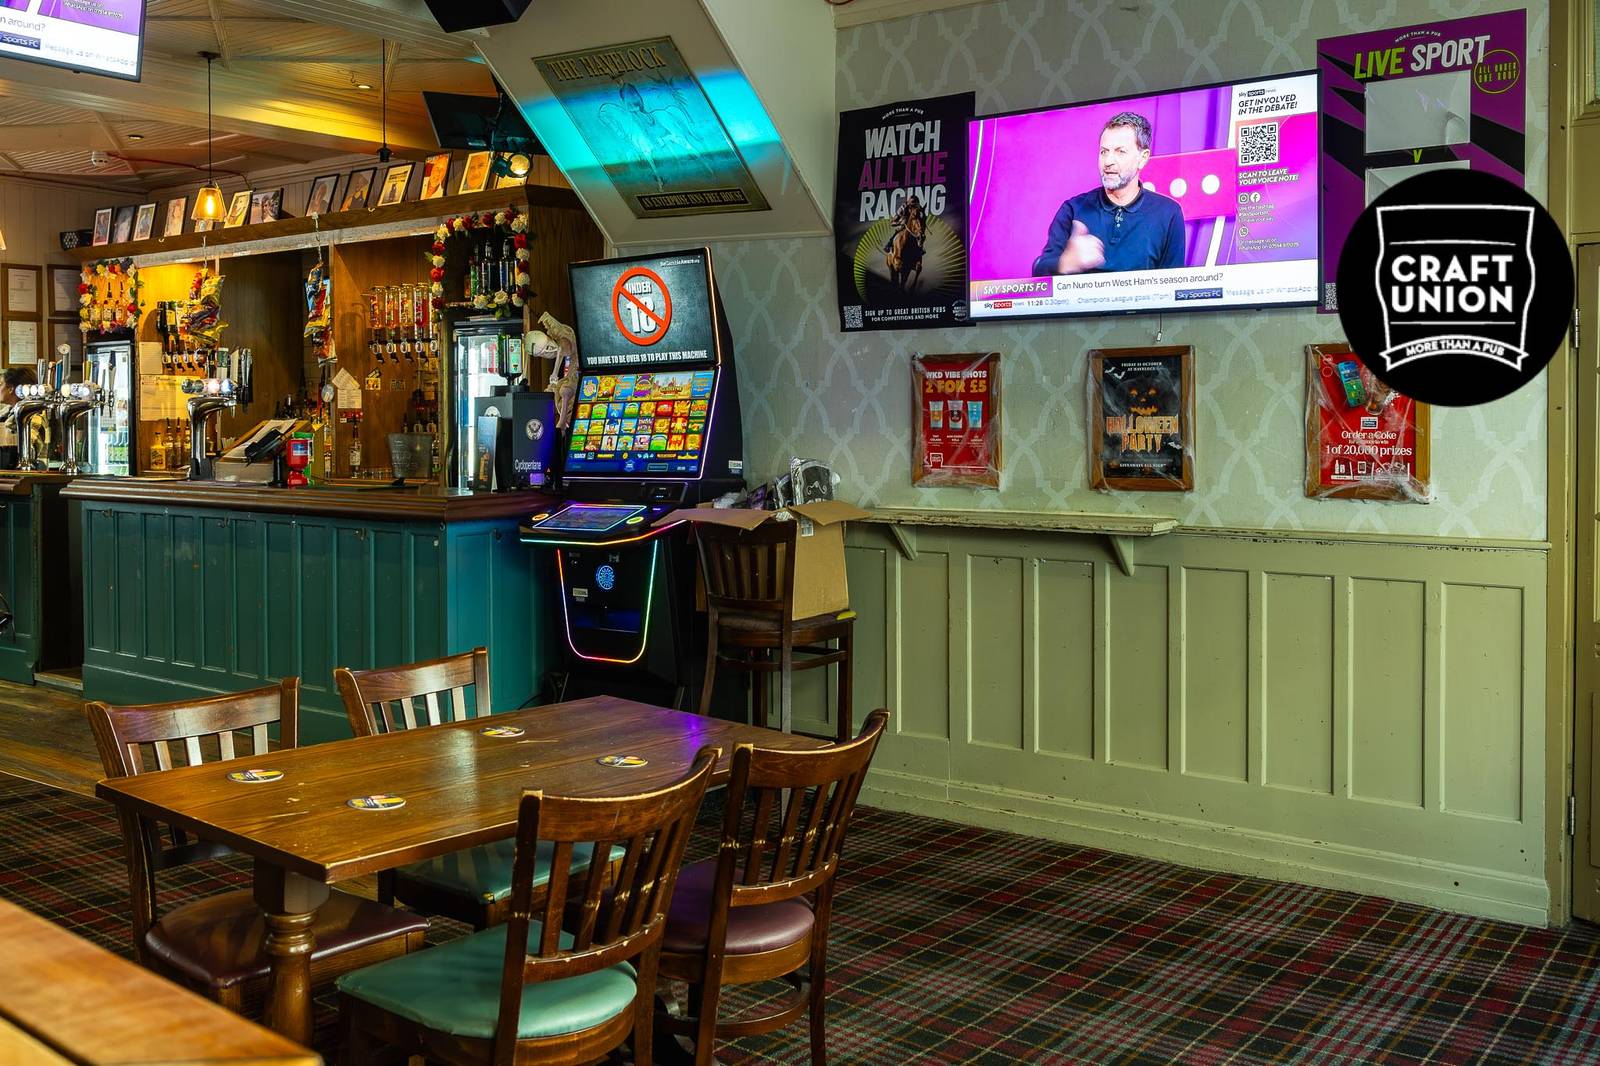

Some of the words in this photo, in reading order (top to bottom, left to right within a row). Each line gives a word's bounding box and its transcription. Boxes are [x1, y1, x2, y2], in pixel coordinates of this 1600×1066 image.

[7, 18, 46, 31] around?
[3, 35, 28, 46] Sports
[28, 39, 39, 48] FC
[1394, 33, 1410, 43] MORE
[546, 60, 584, 81] THE
[580, 46, 667, 78] HAVELOCK
[1353, 47, 1406, 80] LIVE
[1410, 34, 1491, 72] SPORT
[1478, 73, 1492, 83] ONE
[1248, 89, 1265, 97] sports
[1238, 100, 1255, 108] GET
[1255, 94, 1297, 106] INVOLVED
[1248, 106, 1264, 114] THE
[1264, 101, 1298, 112] DEBATE!
[882, 110, 896, 120] MORE
[865, 120, 941, 159] WATCH
[857, 158, 900, 191] ALL
[901, 151, 949, 185] THE
[1238, 171, 1258, 179] SCAN
[1268, 168, 1288, 176] LEAVE
[1257, 176, 1278, 184] VOICE
[1278, 174, 1299, 182] NOTE!
[859, 184, 947, 222] RACING
[1073, 281, 1093, 289] Nuno
[1094, 280, 1111, 288] turn
[1111, 279, 1132, 287] West
[1133, 277, 1158, 286] Ham's
[1159, 276, 1188, 285] season
[1189, 272, 1223, 283] around?
[625, 281, 653, 295] UNDER
[983, 285, 1000, 295] SKY
[1001, 283, 1034, 294] SPORTS
[1035, 282, 1048, 291] FC
[1176, 291, 1189, 300] Sky
[1189, 290, 1211, 298] Sports
[627, 296, 657, 333] 18
[587, 356, 598, 365] YOU
[598, 355, 611, 365] HAVE
[611, 355, 619, 364] TO
[619, 354, 626, 363] BE
[626, 353, 640, 363] OVER
[640, 353, 647, 362] 18
[647, 353, 655, 362] TO
[655, 352, 668, 361] PLAY
[668, 351, 682, 360] THIS
[681, 349, 708, 360] MACHINE
[926, 371, 943, 379] WKD
[945, 370, 961, 378] VIBE
[962, 370, 988, 378] SHOTS
[925, 380, 934, 393] 2
[937, 379, 966, 393] FOR
[970, 380, 988, 393] £5
[1106, 414, 1179, 437] HALLOWEEN
[1341, 430, 1367, 439] Order
[1373, 430, 1397, 440] Coke
[1121, 431, 1163, 453] PARTY
[1326, 445, 1331, 455] 1
[1331, 444, 1342, 455] of
[1343, 445, 1379, 456] 20,000
[1380, 445, 1412, 457] prizes
